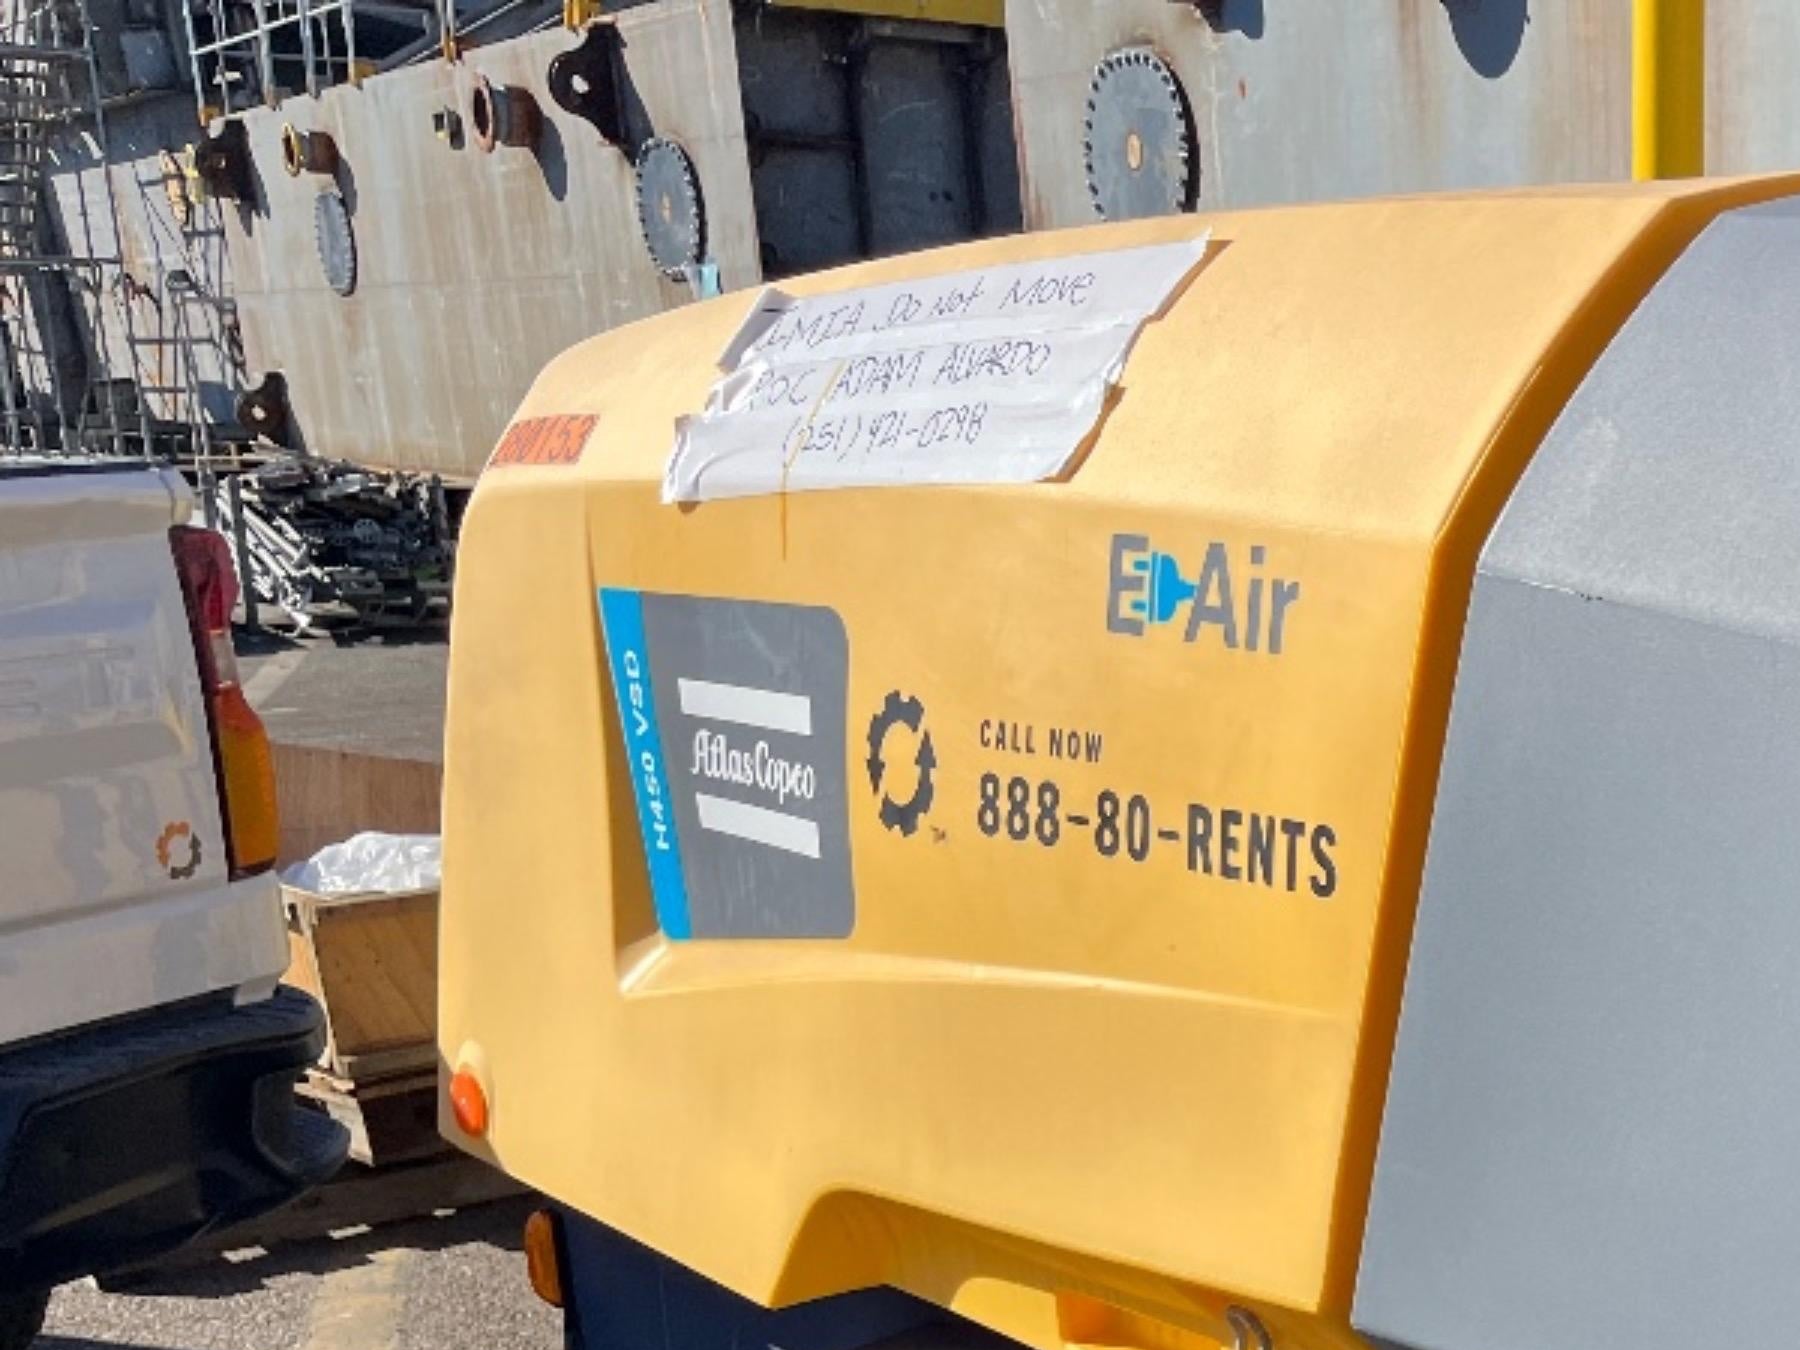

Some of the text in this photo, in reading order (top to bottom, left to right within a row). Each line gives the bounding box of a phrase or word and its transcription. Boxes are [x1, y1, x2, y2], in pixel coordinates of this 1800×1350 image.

[623, 649, 650, 737] VSD
[689, 728, 815, 805] Atlas Copco
[980, 718, 1103, 763] CALL NOW
[977, 771, 1338, 898] 888-80-RENTS
